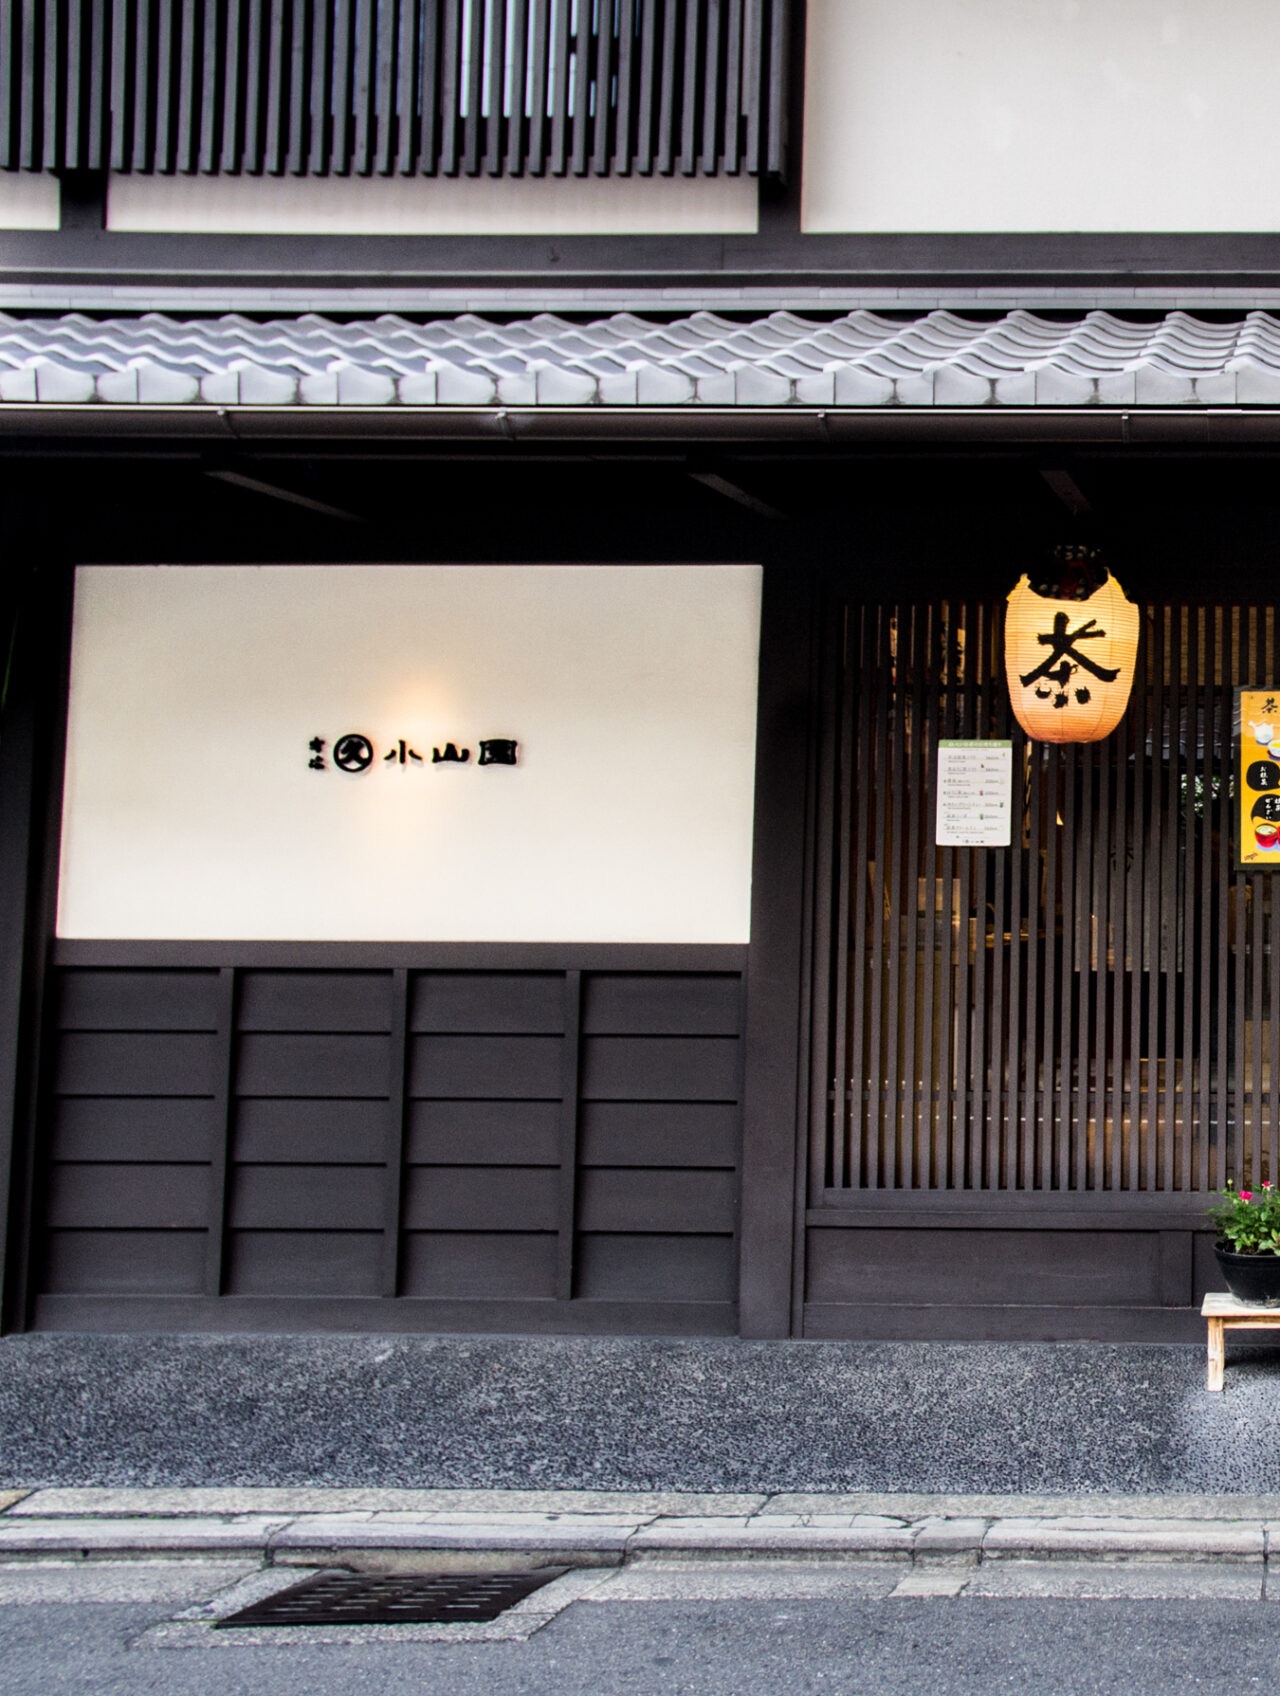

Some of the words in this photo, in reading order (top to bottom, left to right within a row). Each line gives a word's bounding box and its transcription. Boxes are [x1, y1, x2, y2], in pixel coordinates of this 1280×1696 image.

[1019, 612, 1121, 709] 茶
[1260, 766, 1269, 786] お抹茶
